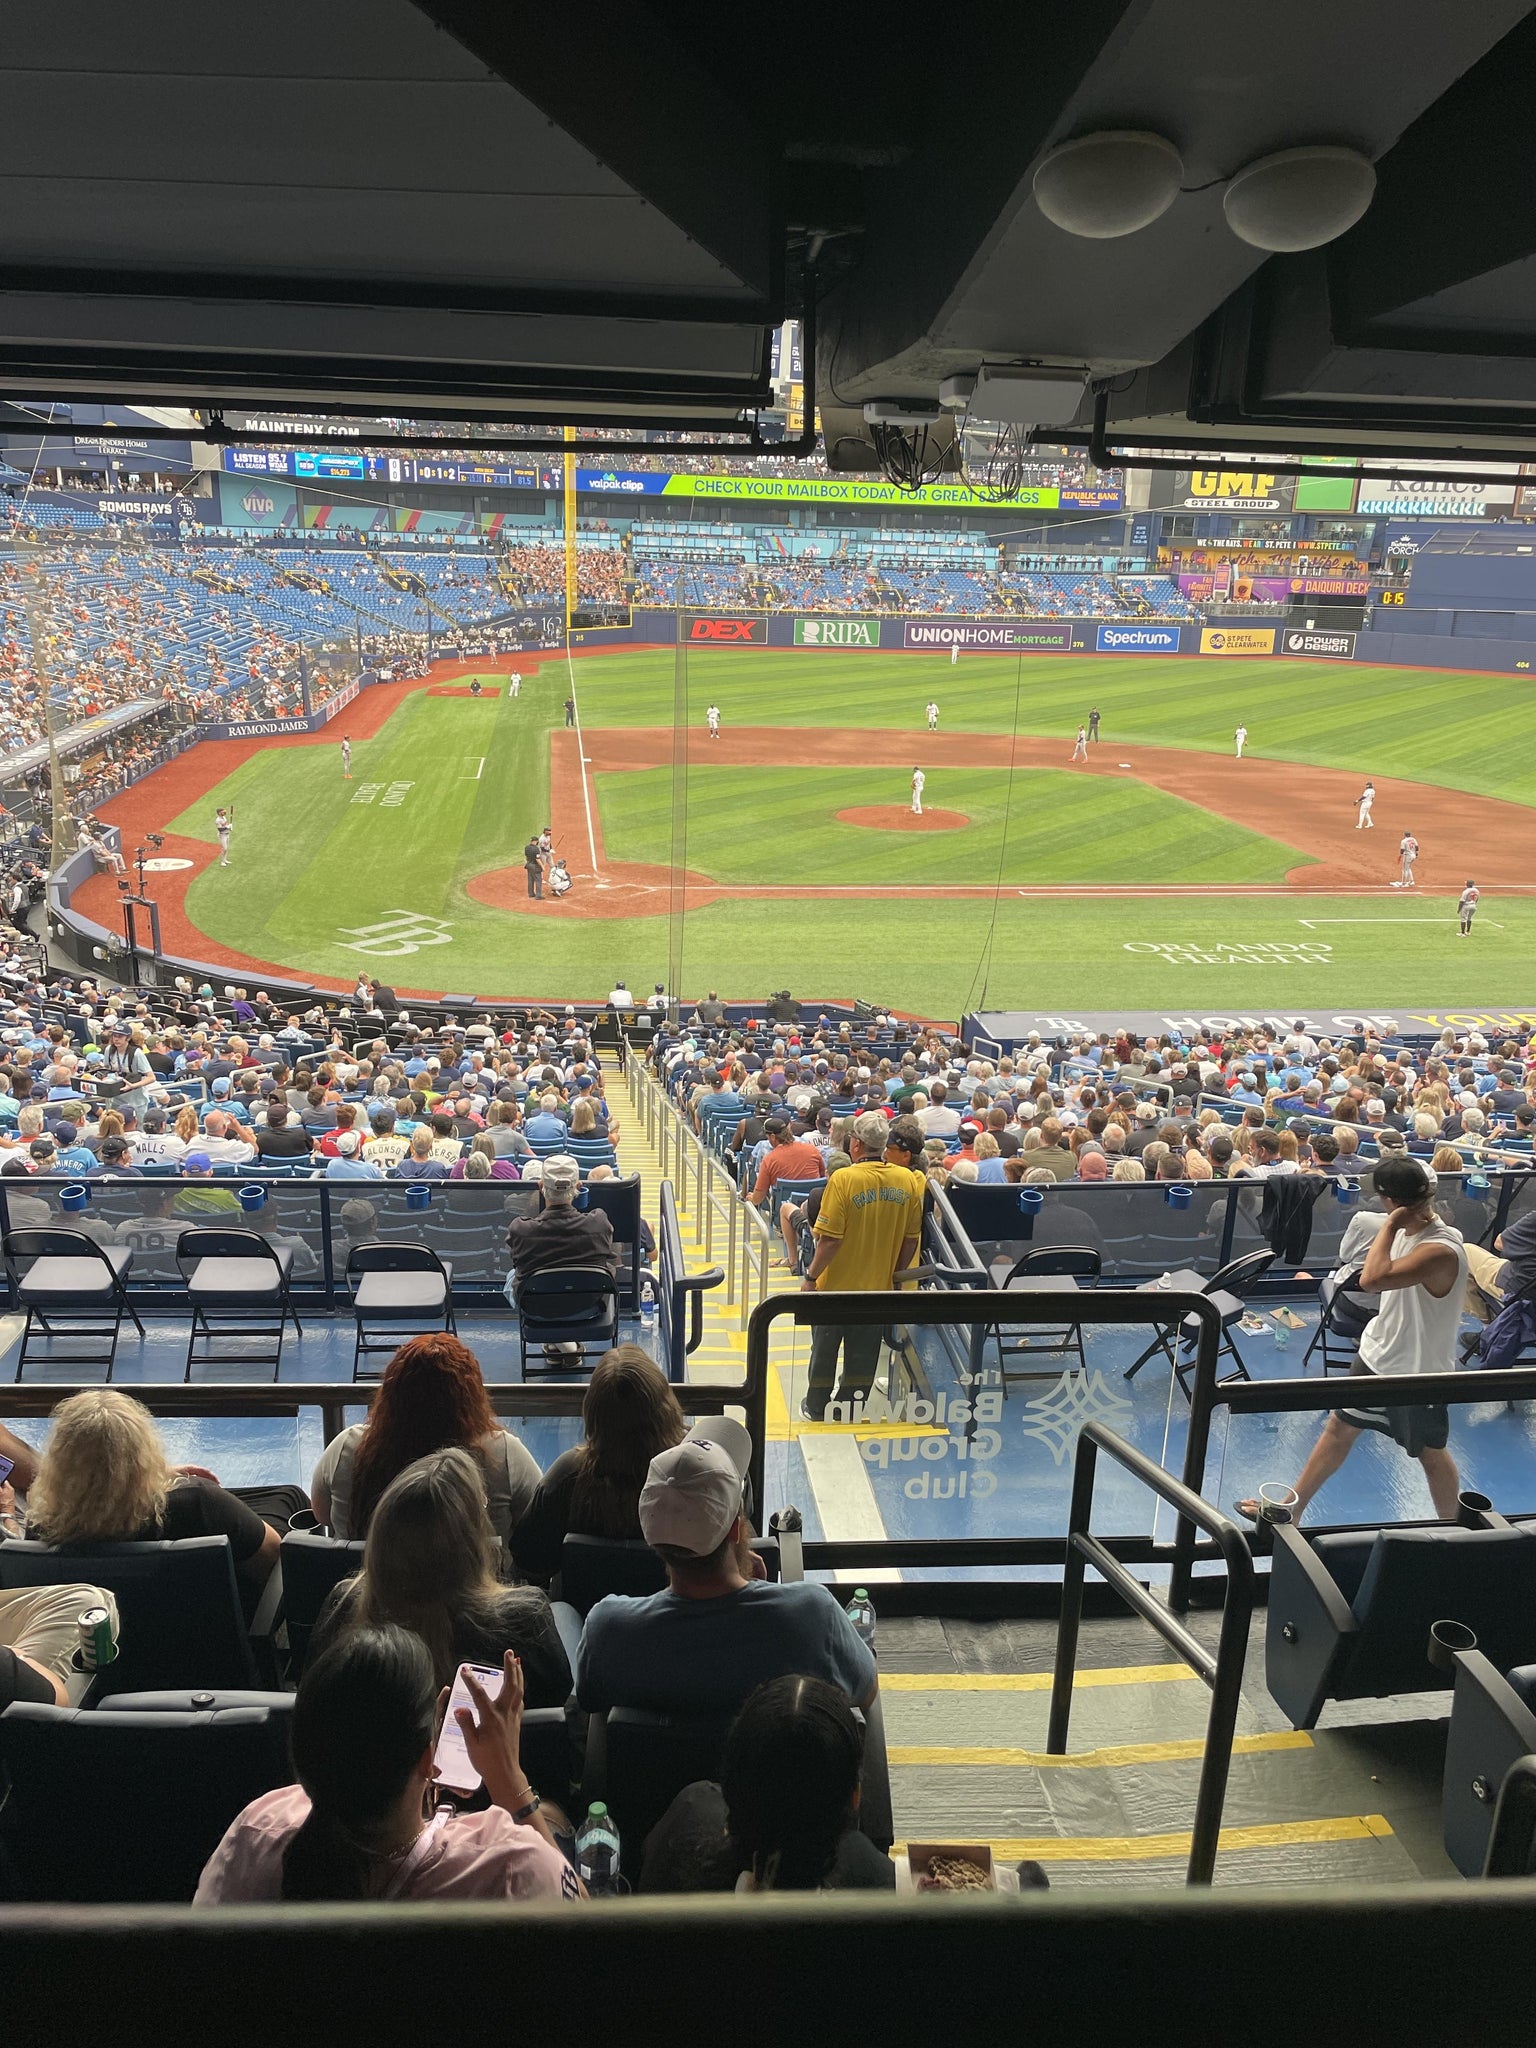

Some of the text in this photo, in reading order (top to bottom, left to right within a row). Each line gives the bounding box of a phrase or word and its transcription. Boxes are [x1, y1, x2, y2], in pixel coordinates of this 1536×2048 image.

[245, 419, 360, 436] MAINTENX.COM
[233, 453, 287, 463] LISTEN 95.7
[448, 468, 456, 480] 2
[589, 479, 620, 491] valpak
[694, 480, 1039, 504] CHECK YOUR MAILBOX TODAY FOR GREAT SANGS
[1061, 491, 1118, 501] REPUBLIC BANK
[243, 497, 274, 512] VIVA
[1191, 499, 1273, 508] STEEL GROUP
[1394, 495, 1476, 503] FURNITURE
[99, 500, 172, 515] SOMOS RAYS
[1213, 539, 1225, 547] THE
[1275, 541, 1291, 549] PETE
[1387, 546, 1419, 555] PORCH
[1305, 581, 1370, 595] DAIQUIRI DECK
[691, 620, 757, 640] DEX
[821, 622, 873, 645] RIPA
[1013, 635, 1064, 645] MORTGAGE
[1103, 630, 1168, 647] Spectrum
[1226, 641, 1268, 649] CLEARWATER
[1516, 661, 1530, 669] 404
[228, 720, 309, 737] RAYMOND JAMES
[1122, 942, 1333, 954] ORLANDO
[1157, 953, 1337, 965] HEALTH
[1161, 1016, 1323, 1032] HOME
[1330, 1015, 1400, 1029] OF
[136, 1142, 167, 1155] WALLS
[367, 1145, 402, 1157] ALONSO
[851, 1186, 911, 1210] FAN HOST
